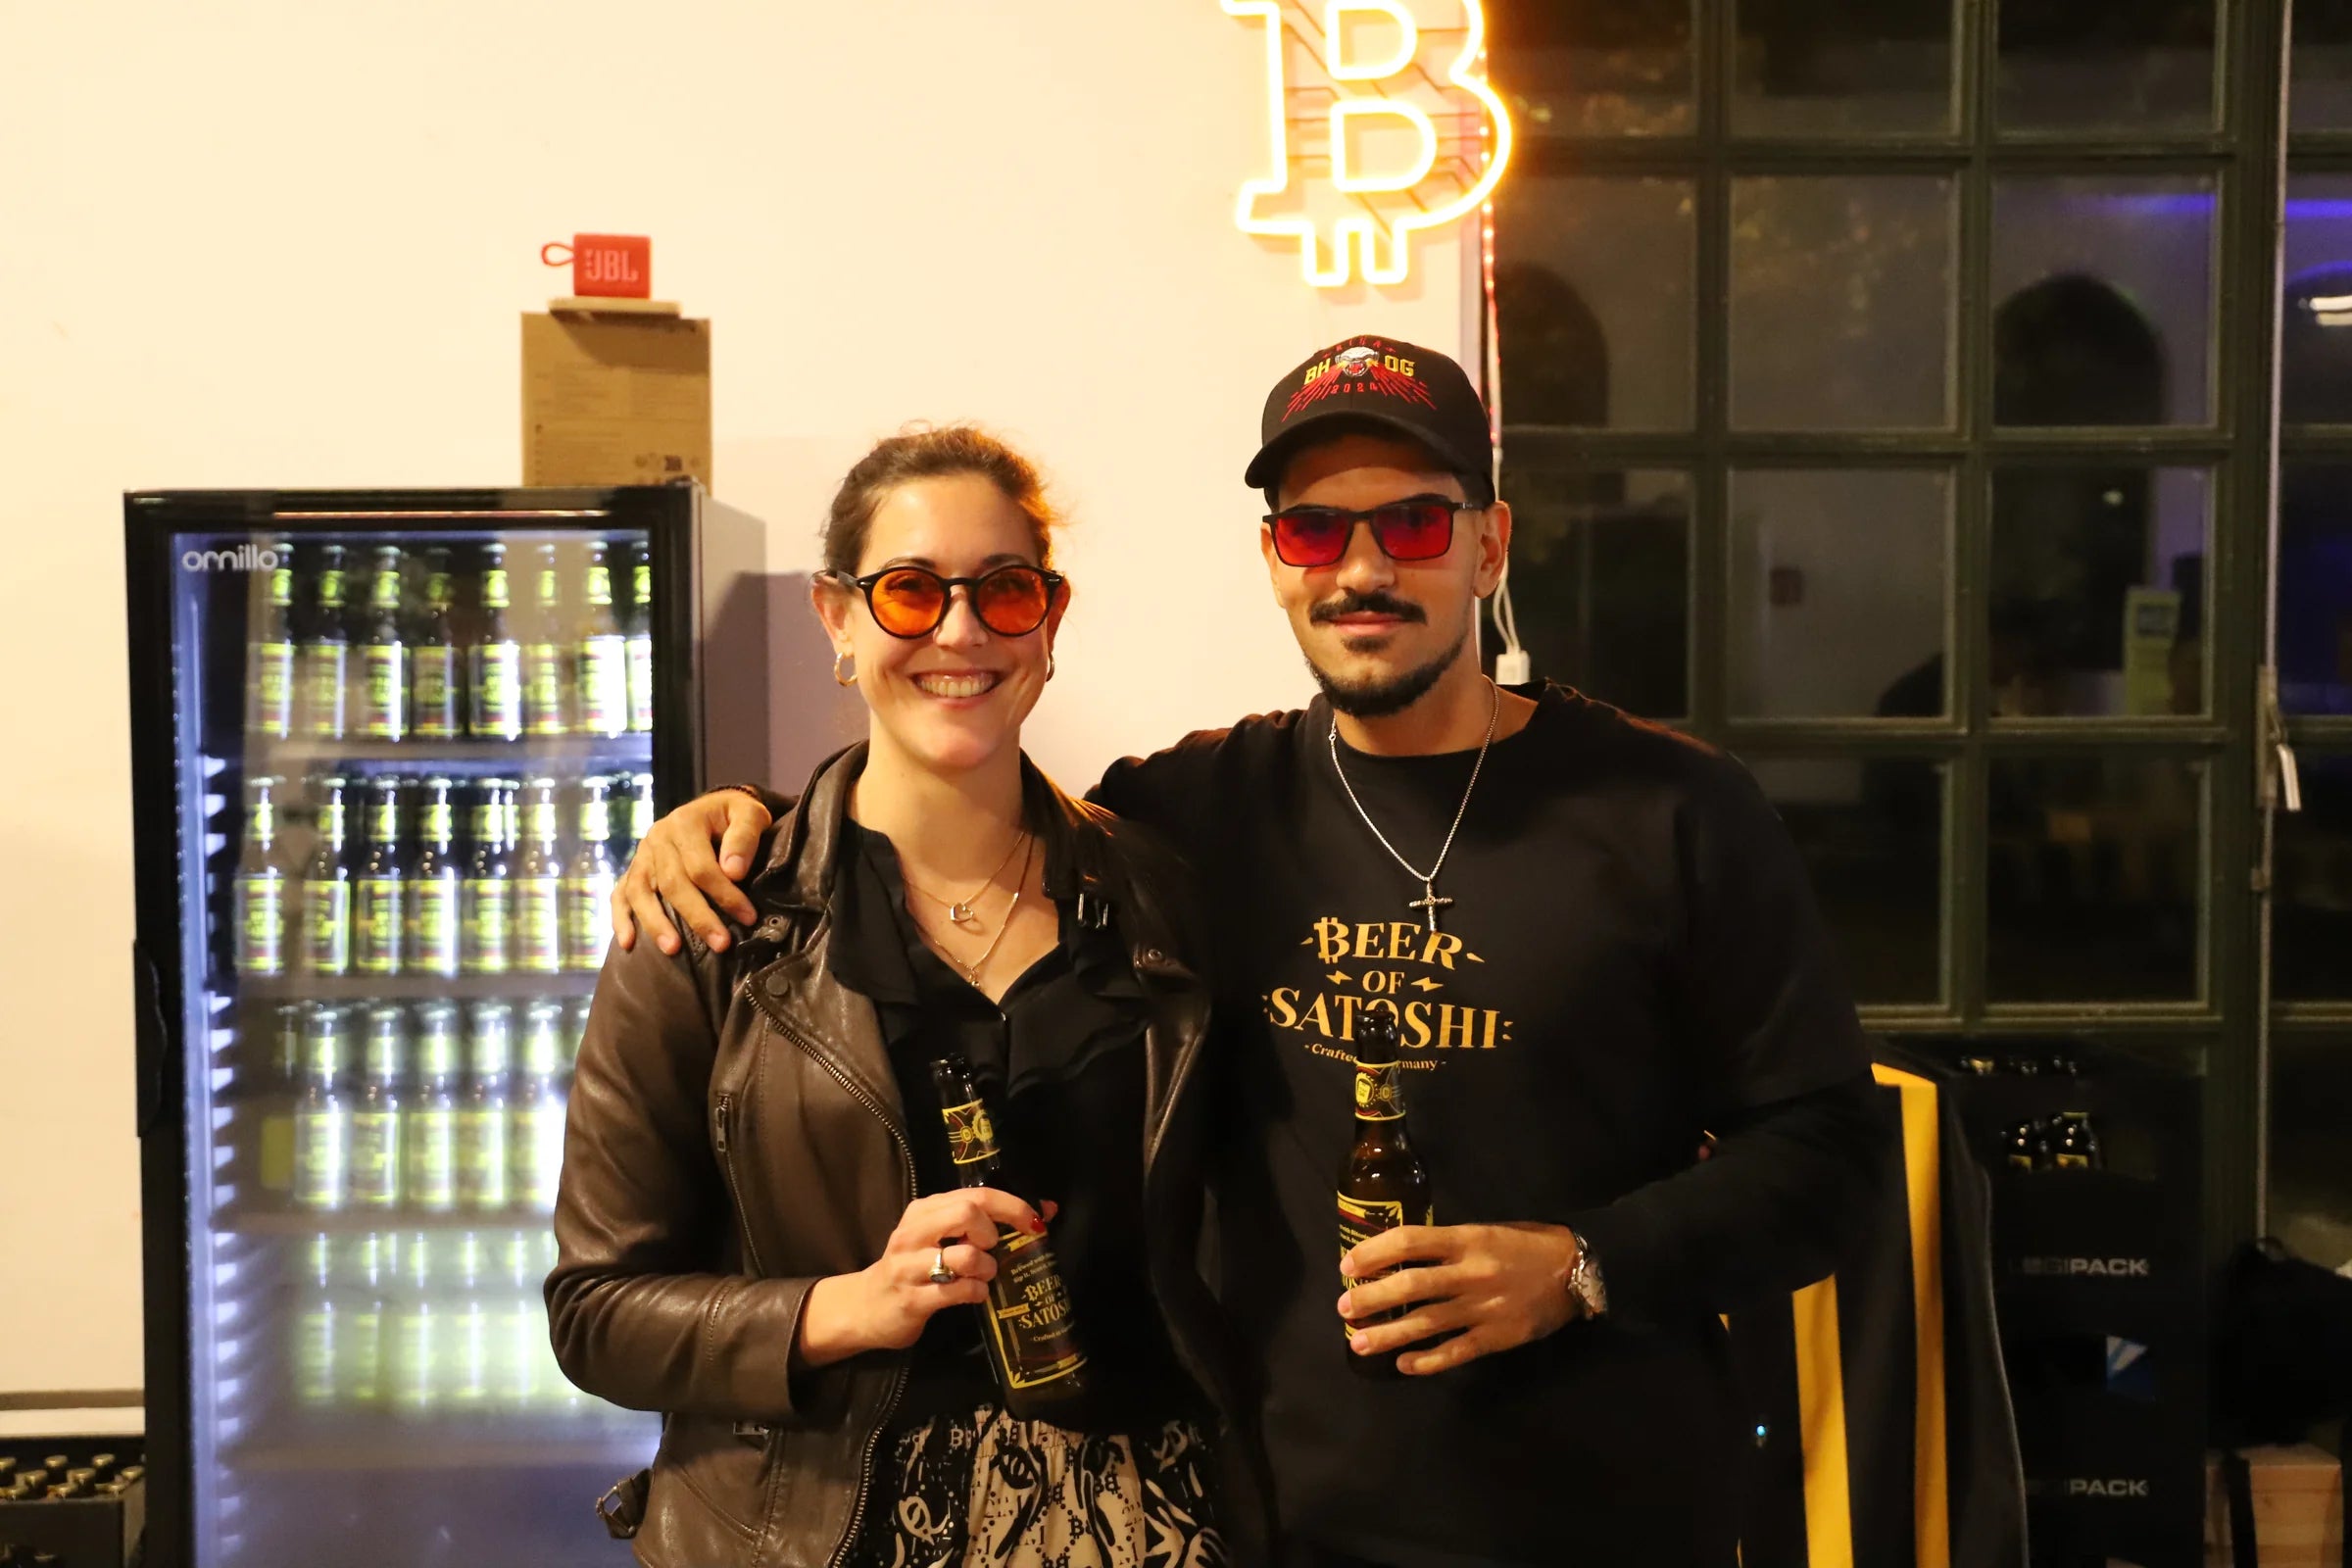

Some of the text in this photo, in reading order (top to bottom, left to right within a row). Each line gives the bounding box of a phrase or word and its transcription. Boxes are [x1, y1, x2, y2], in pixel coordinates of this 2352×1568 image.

[585, 249, 638, 282] JBL
[1304, 355, 1416, 385] BH OG
[1362, 970, 1405, 995] OF
